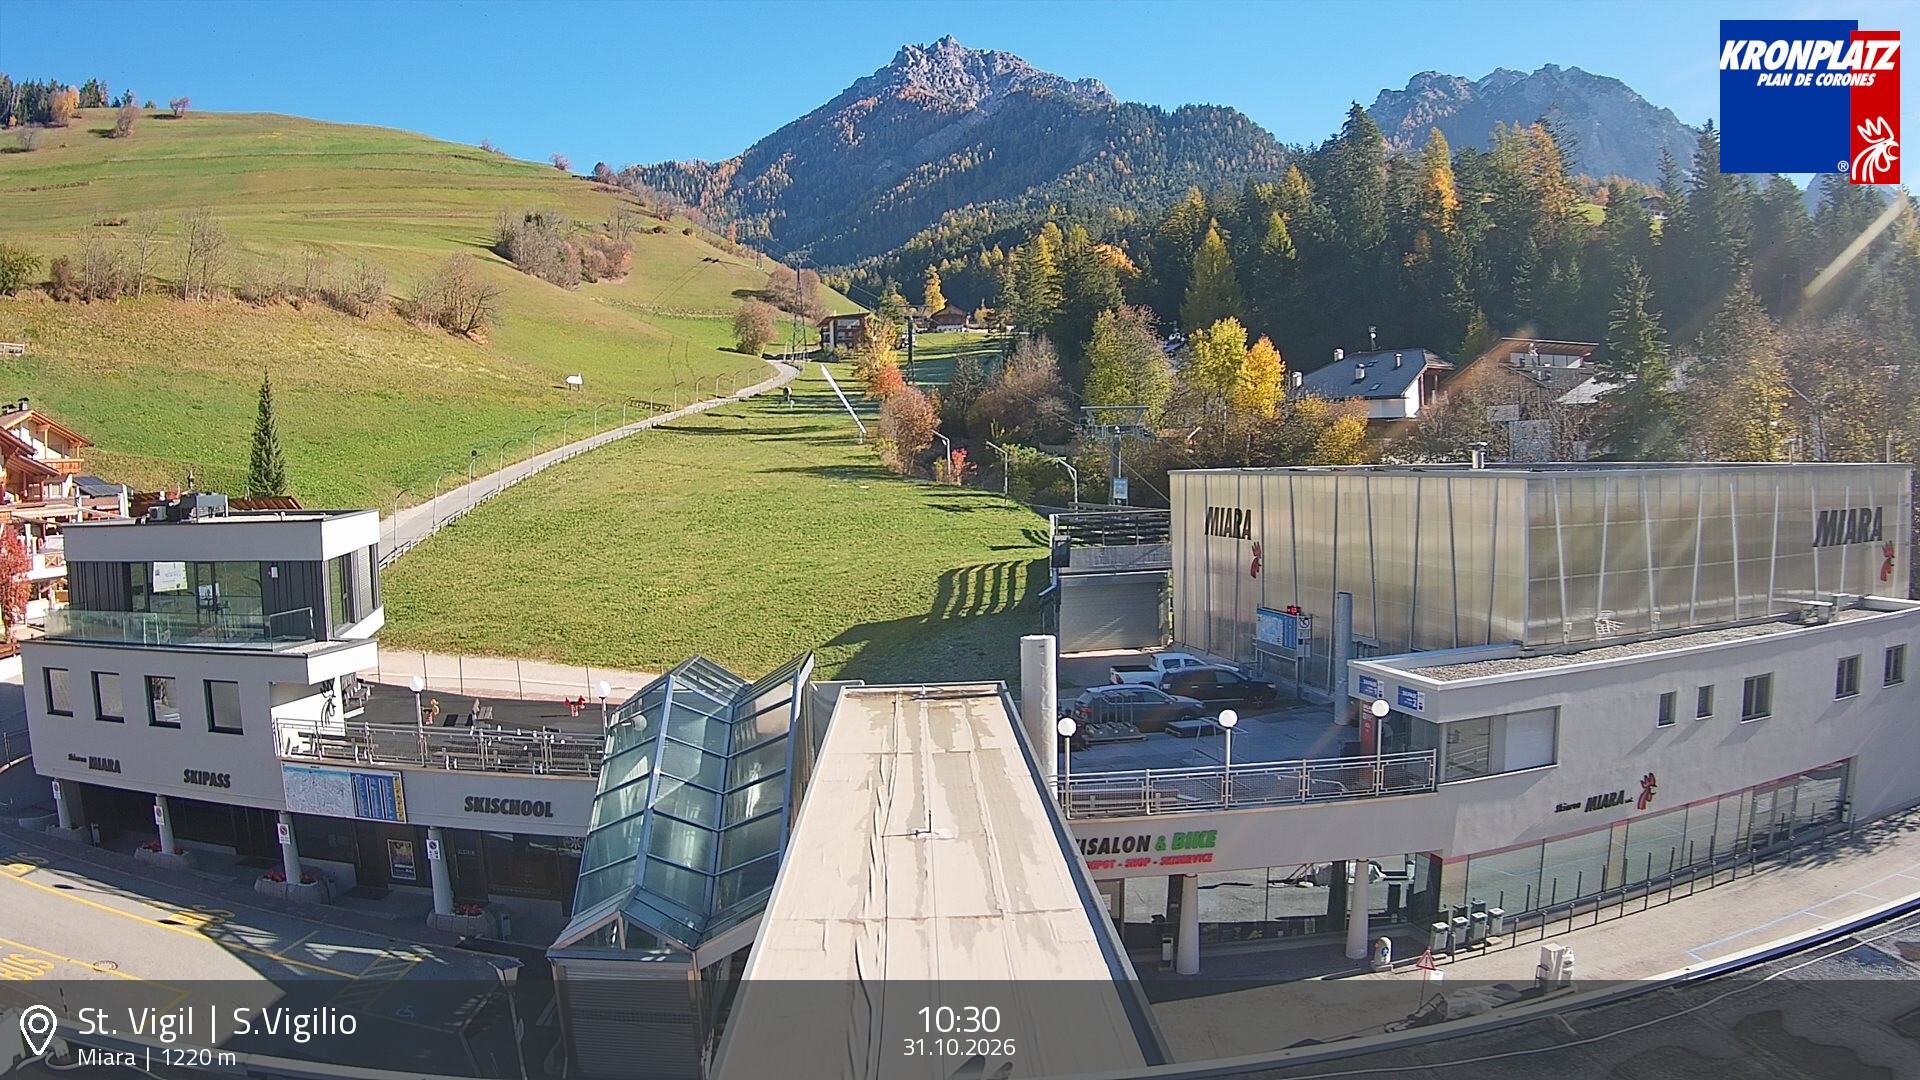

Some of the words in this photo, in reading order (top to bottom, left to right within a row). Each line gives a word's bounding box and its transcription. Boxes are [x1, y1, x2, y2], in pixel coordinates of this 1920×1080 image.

[1204, 506, 1252, 540] MIARA
[1812, 506, 1883, 548] MIARA
[89, 756, 121, 774] MIARA
[183, 769, 231, 788] SKIPASS
[464, 796, 553, 818] SKISCHOOL
[1584, 790, 1625, 812] MIARA
[1076, 835, 1151, 855] ISALON
[1155, 836, 1167, 851] &
[1171, 830, 1218, 850] BIKE
